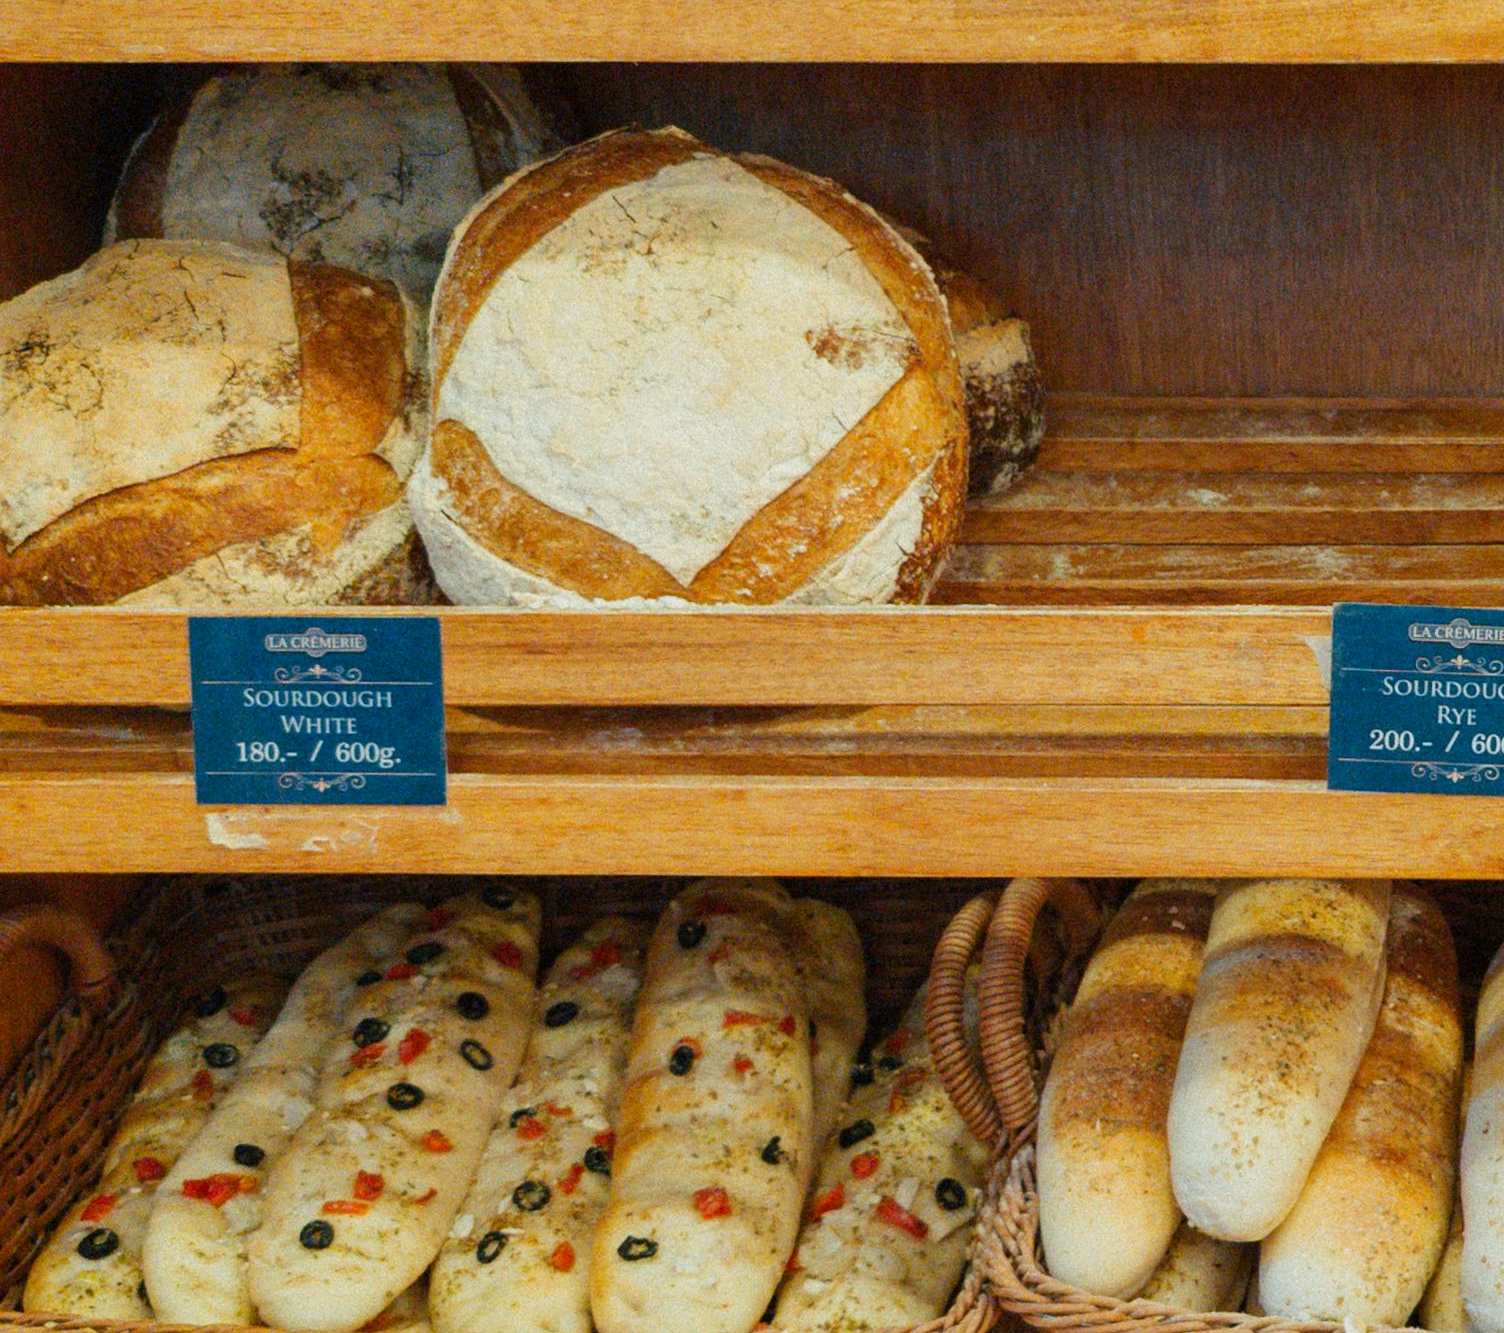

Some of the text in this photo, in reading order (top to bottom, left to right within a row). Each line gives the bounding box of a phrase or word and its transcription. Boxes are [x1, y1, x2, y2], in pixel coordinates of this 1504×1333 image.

[1412, 625, 1432, 638] LA
[269, 636, 287, 649] LA
[243, 687, 393, 708] SOURDOUGH
[280, 715, 358, 734] WHITE
[1437, 705, 1477, 726] RYE
[1369, 729, 1433, 752] 200.-
[1445, 731, 1460, 752] /
[236, 740, 402, 769] 180.- / 600g.
